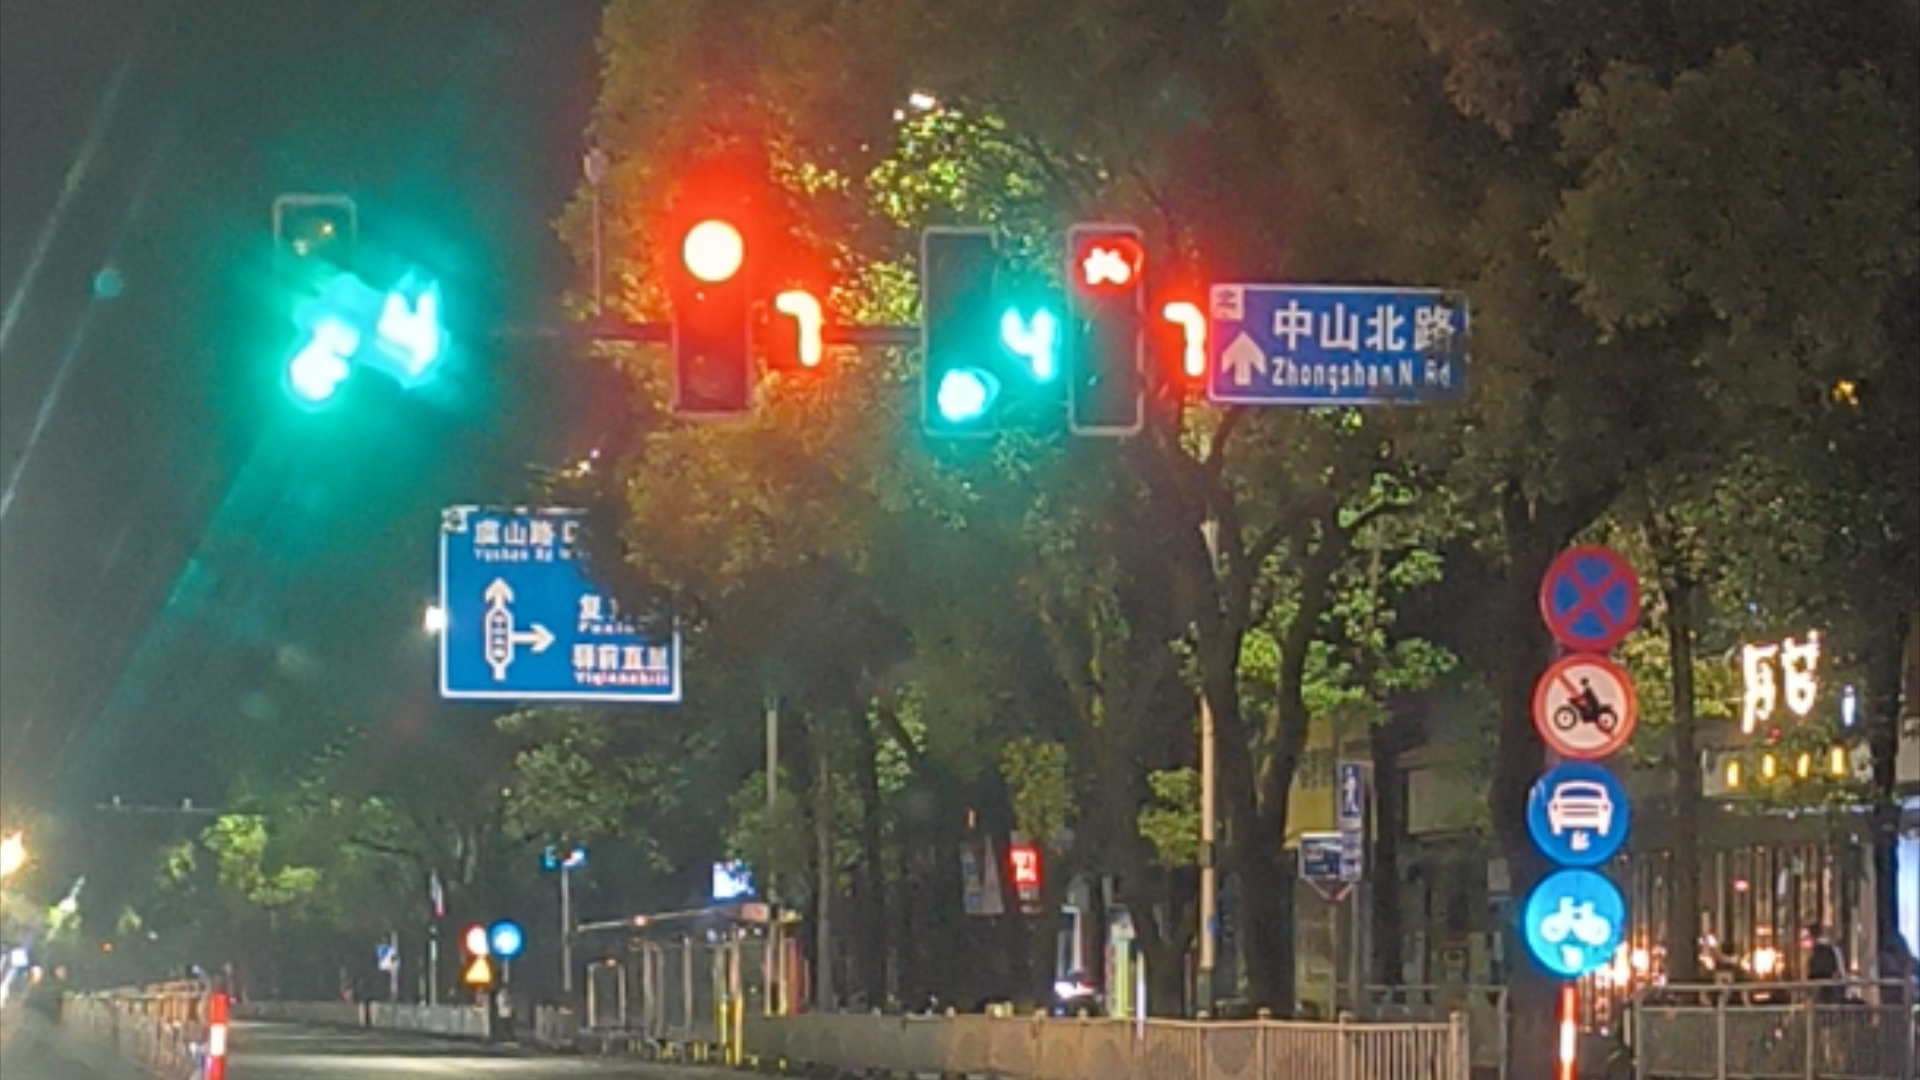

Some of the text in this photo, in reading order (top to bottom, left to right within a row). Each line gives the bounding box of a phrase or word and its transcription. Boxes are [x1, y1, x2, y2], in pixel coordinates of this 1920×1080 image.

[1001, 305, 1059, 382] 4
[1274, 299, 1455, 352] 中山北路
[1272, 357, 1394, 394] Zhongshan
